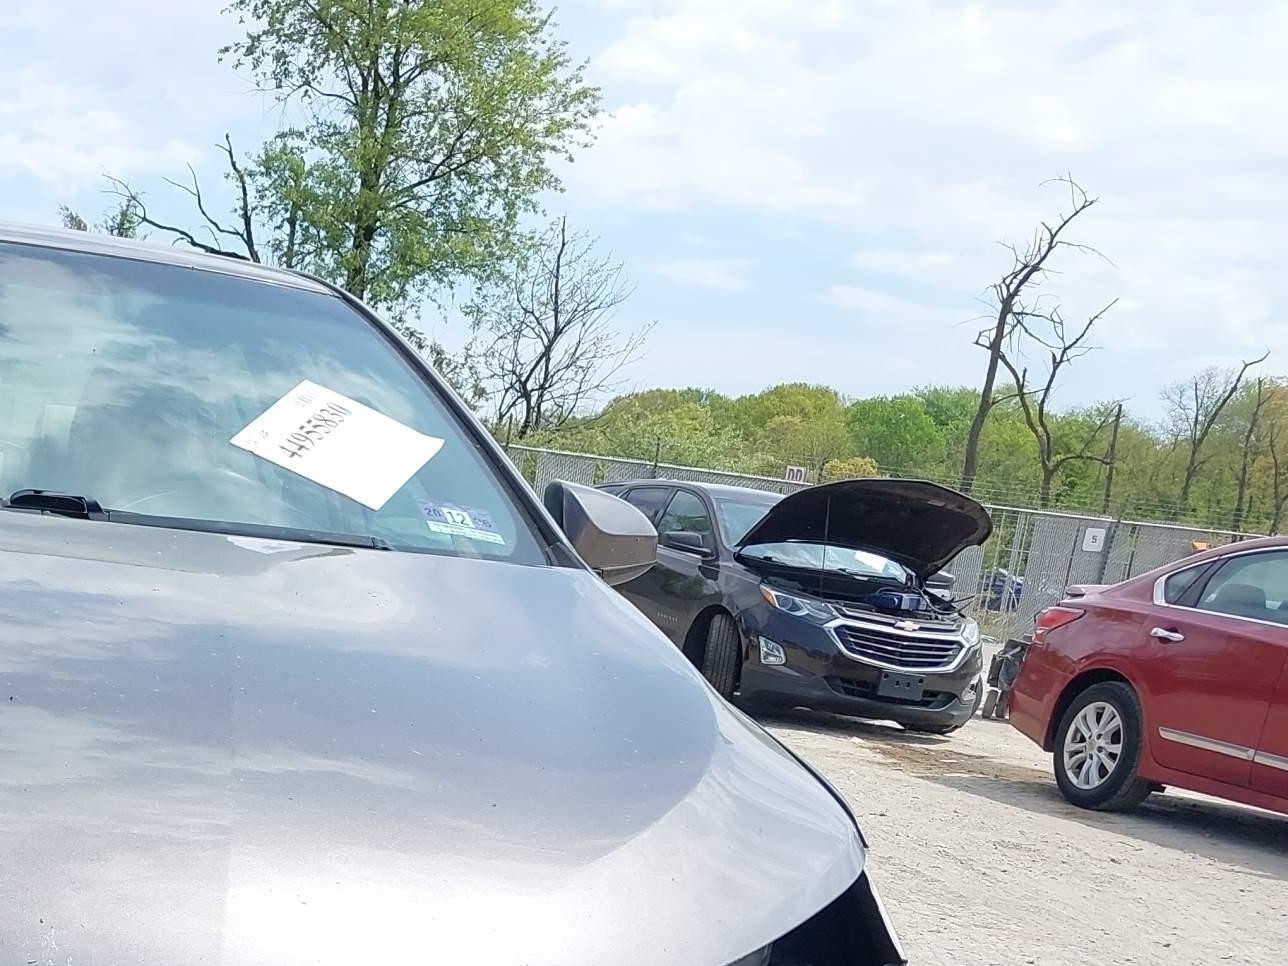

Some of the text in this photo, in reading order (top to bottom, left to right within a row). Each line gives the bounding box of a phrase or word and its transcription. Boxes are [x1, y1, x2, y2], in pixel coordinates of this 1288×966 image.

[278, 402, 352, 458] 44955830
[446, 511, 470, 526] 12
[1091, 535, 1098, 544] 5
